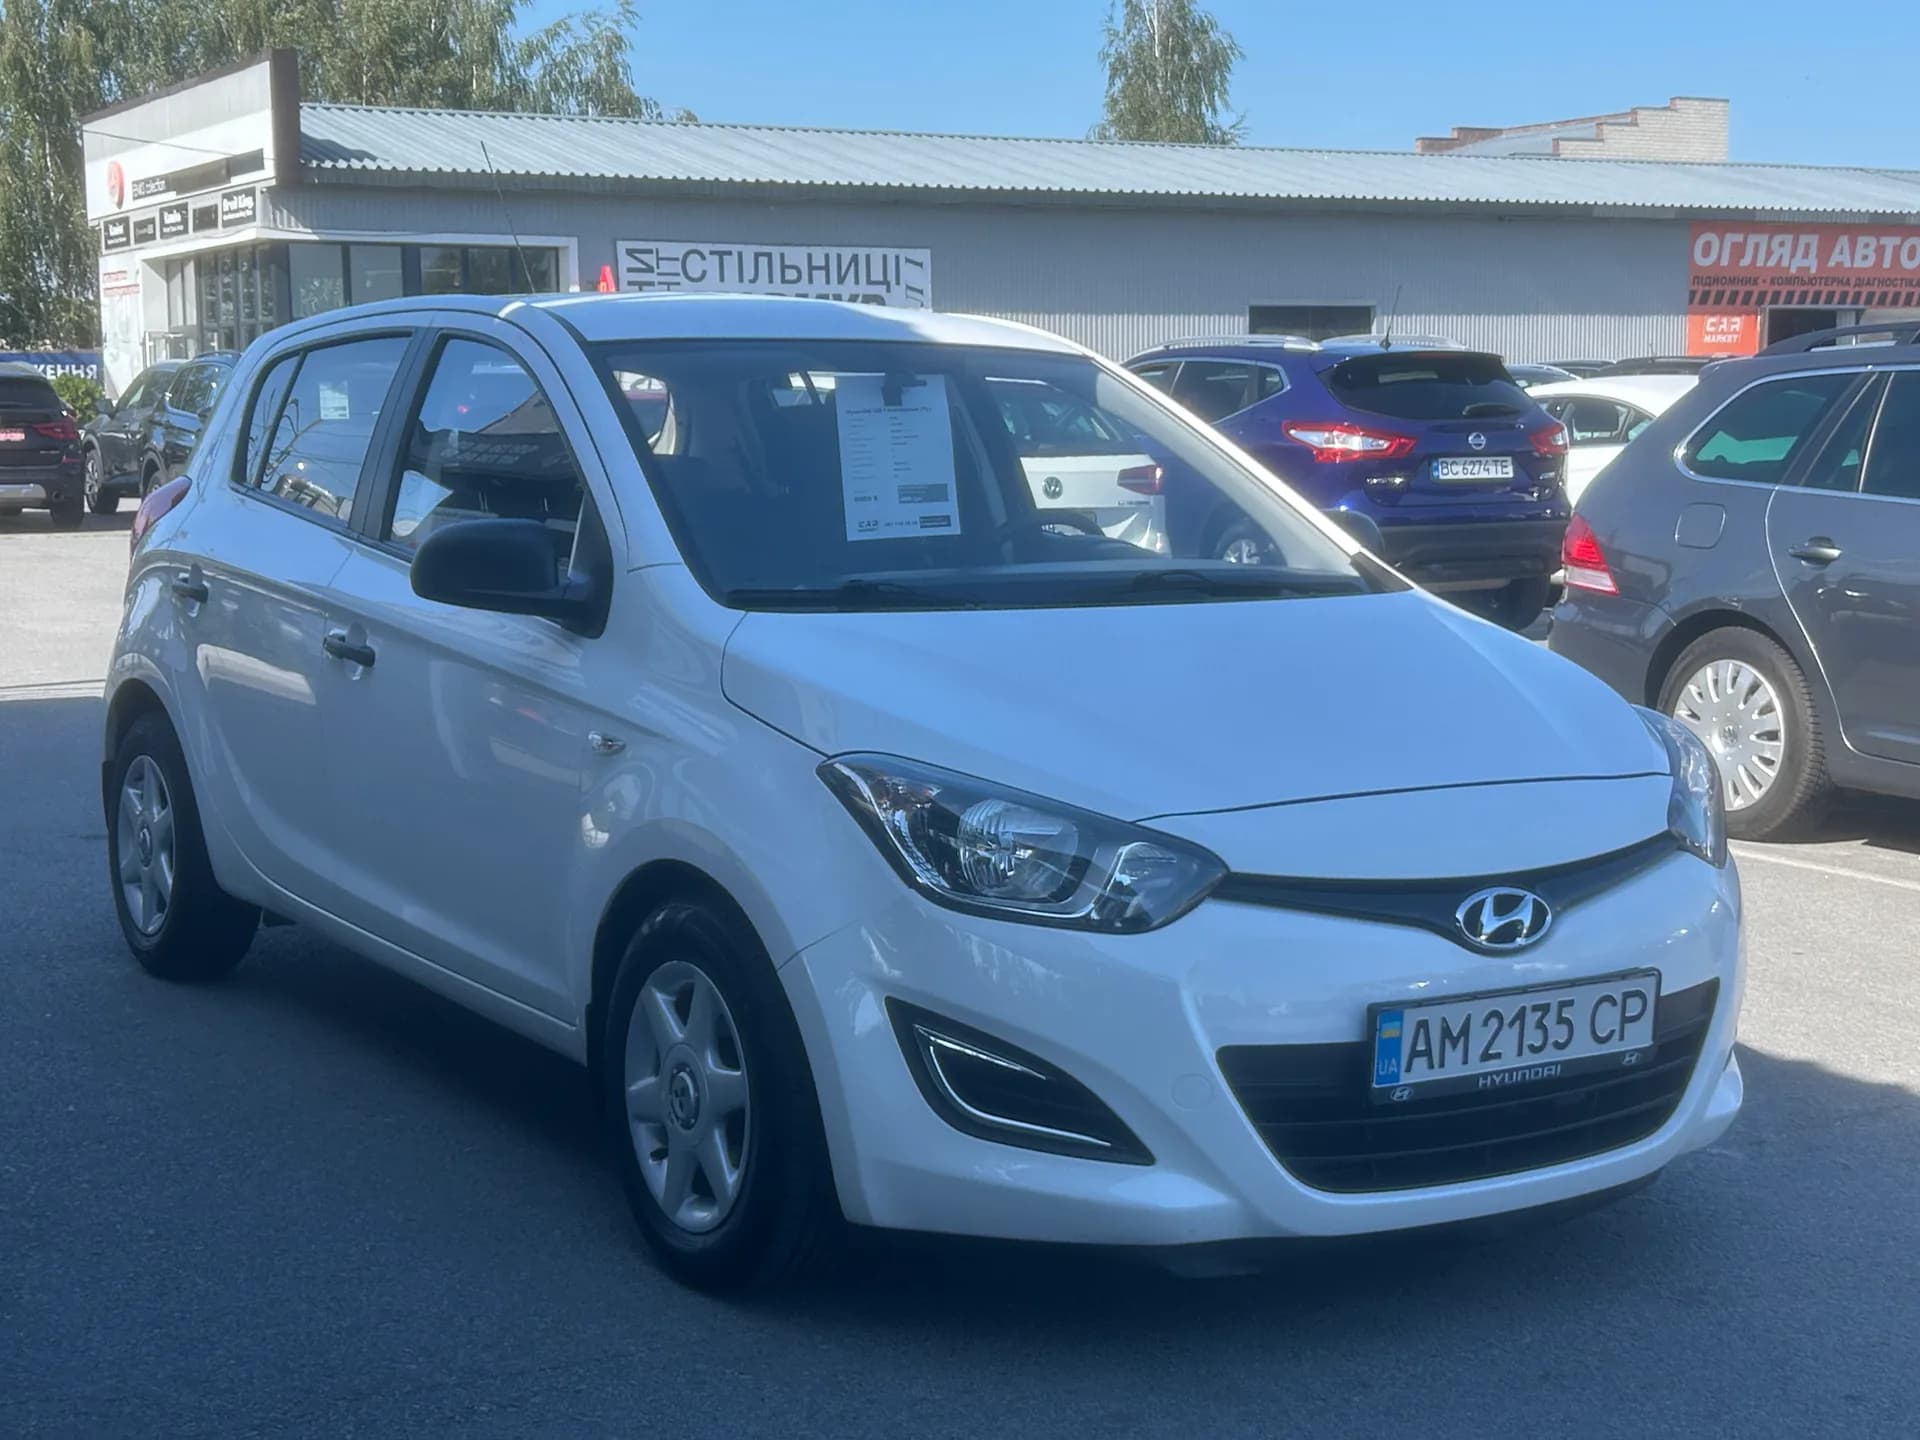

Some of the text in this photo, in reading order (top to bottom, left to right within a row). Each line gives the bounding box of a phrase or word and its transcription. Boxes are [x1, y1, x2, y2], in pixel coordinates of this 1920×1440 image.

[1693, 231, 1920, 274] ОГЛЯД АВТО
[681, 248, 901, 293] СТІЛЬНИЦІ
[1705, 316, 1742, 332] CAR
[1703, 334, 1739, 344] MARKET
[1440, 459, 1511, 477] BC 6274 TE
[1404, 988, 1649, 1073] AM 2135 CP
[1377, 1057, 1399, 1077] UA
[1478, 1063, 1562, 1089] HYUNDAI
